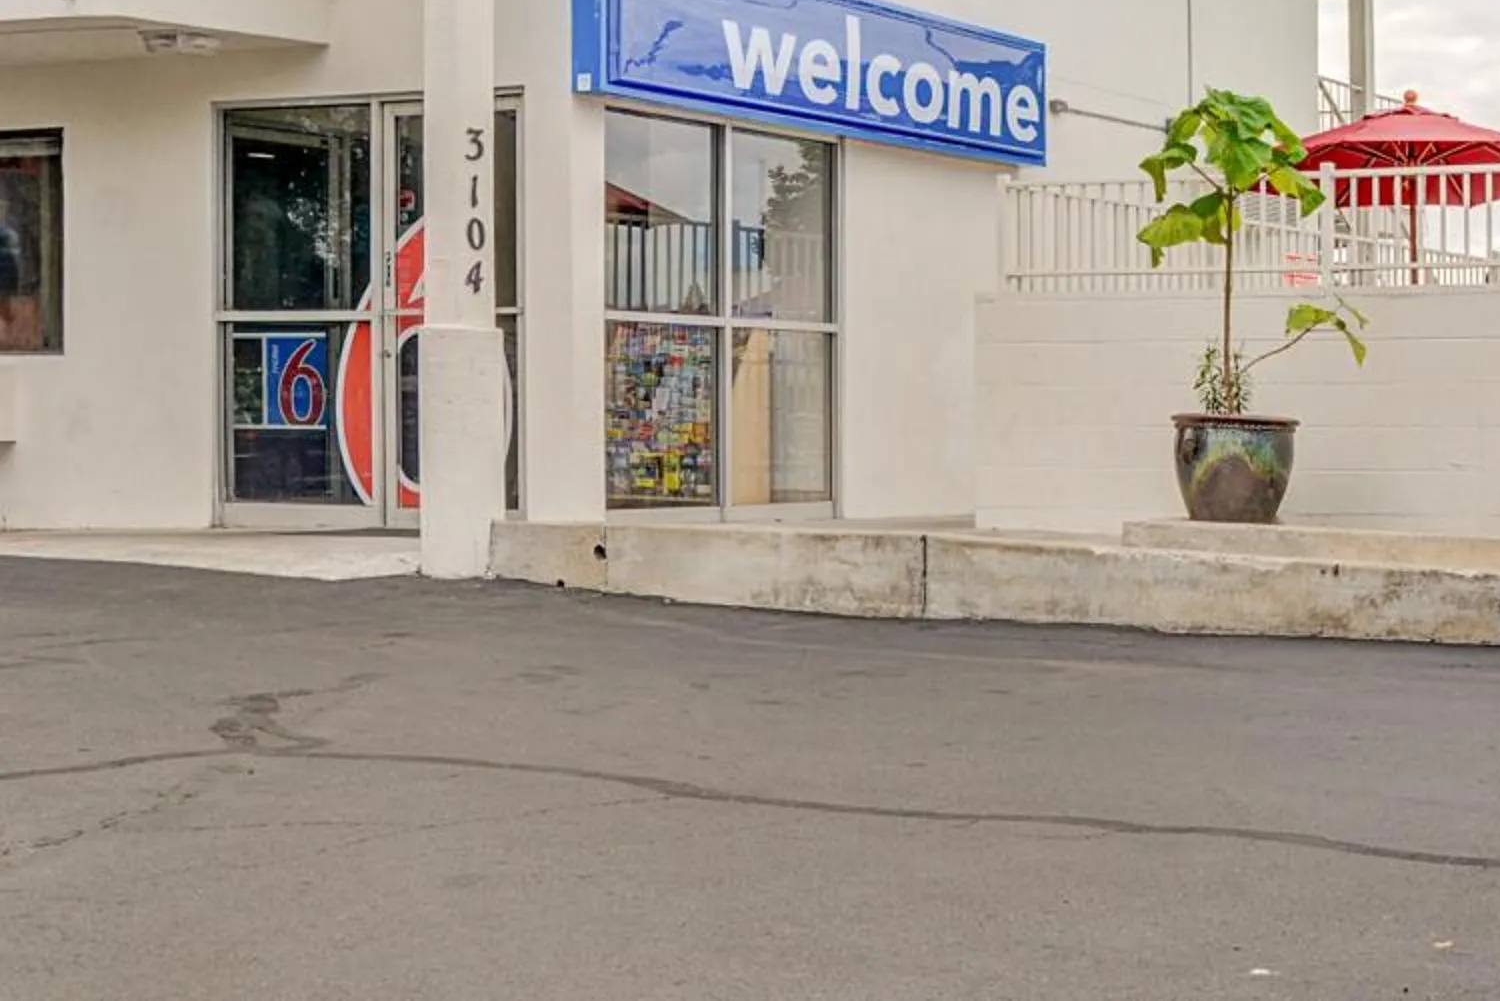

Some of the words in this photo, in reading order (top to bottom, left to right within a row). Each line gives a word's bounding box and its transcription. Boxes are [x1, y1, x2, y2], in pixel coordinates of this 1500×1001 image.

[721, 14, 1040, 144] welcome
[463, 128, 486, 295] 3104
[277, 339, 327, 426] 6
